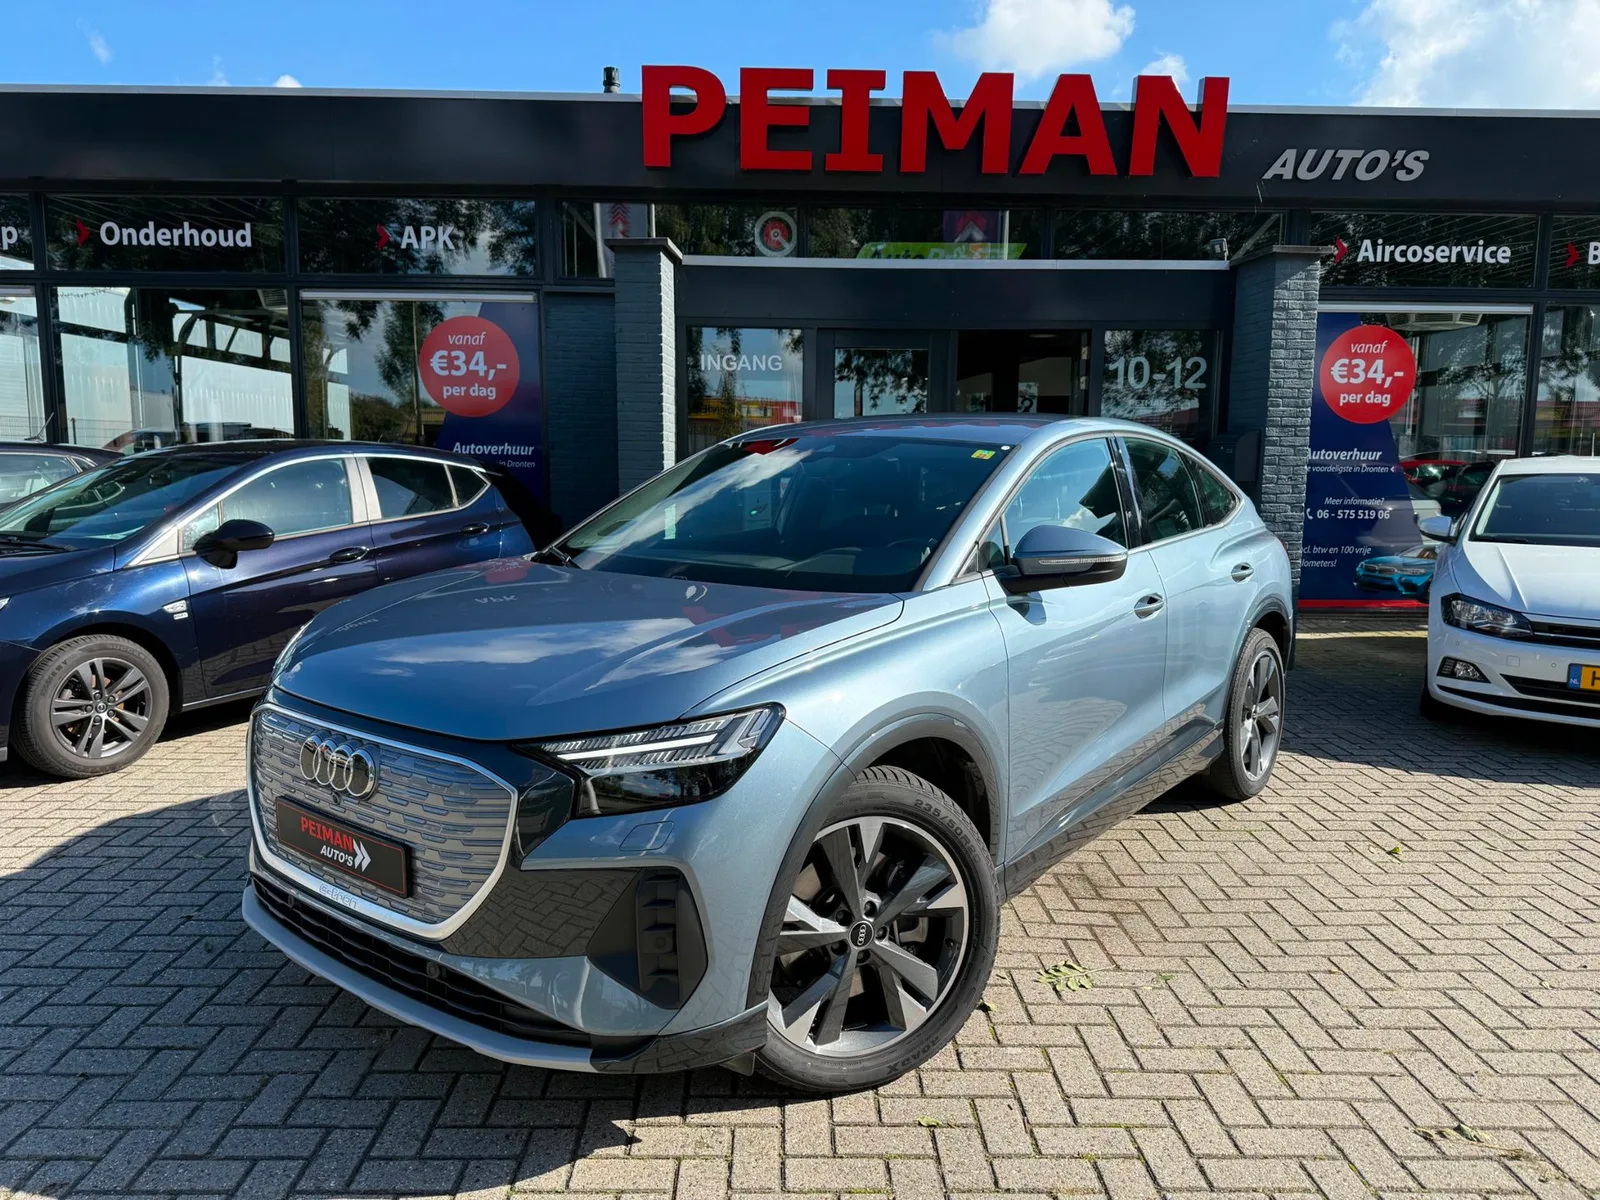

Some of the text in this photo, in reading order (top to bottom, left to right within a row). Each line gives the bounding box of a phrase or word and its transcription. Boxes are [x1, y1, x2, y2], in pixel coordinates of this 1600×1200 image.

[641, 65, 1229, 178] PEIMAN
[1262, 148, 1430, 182] AUTO'S
[100, 221, 252, 248] Onderhoud
[401, 225, 455, 250] APK
[1357, 239, 1511, 264] Aircoservice
[447, 331, 487, 346] vanaf
[1350, 340, 1389, 354] vanaf
[430, 350, 507, 380] €34,-
[700, 354, 783, 372] INGANG
[1108, 356, 1208, 390] 10-12
[1330, 358, 1404, 388] €34,-
[443, 383, 497, 400] per dag
[1339, 390, 1391, 407] per dag
[453, 442, 535, 456] Autoverhuur
[506, 460, 536, 468] Dronten
[1312, 464, 1352, 475] voordeligste
[1353, 464, 1361, 473] in
[1361, 464, 1389, 474] Dronten
[1324, 496, 1385, 506] Meer informatie?
[1316, 509, 1329, 520] 06
[1337, 509, 1356, 519] 575
[1357, 509, 1375, 520] 519
[1377, 509, 1391, 520] 06
[1312, 544, 1328, 554] btw
[1328, 546, 1339, 554] en
[1340, 545, 1354, 555] 100
[1355, 545, 1372, 556] vrije
[1300, 558, 1338, 568] lometers!
[300, 816, 354, 853] PEIMAN
[914, 798, 982, 864] 235/50R20
[320, 844, 354, 867] AUTO'S
